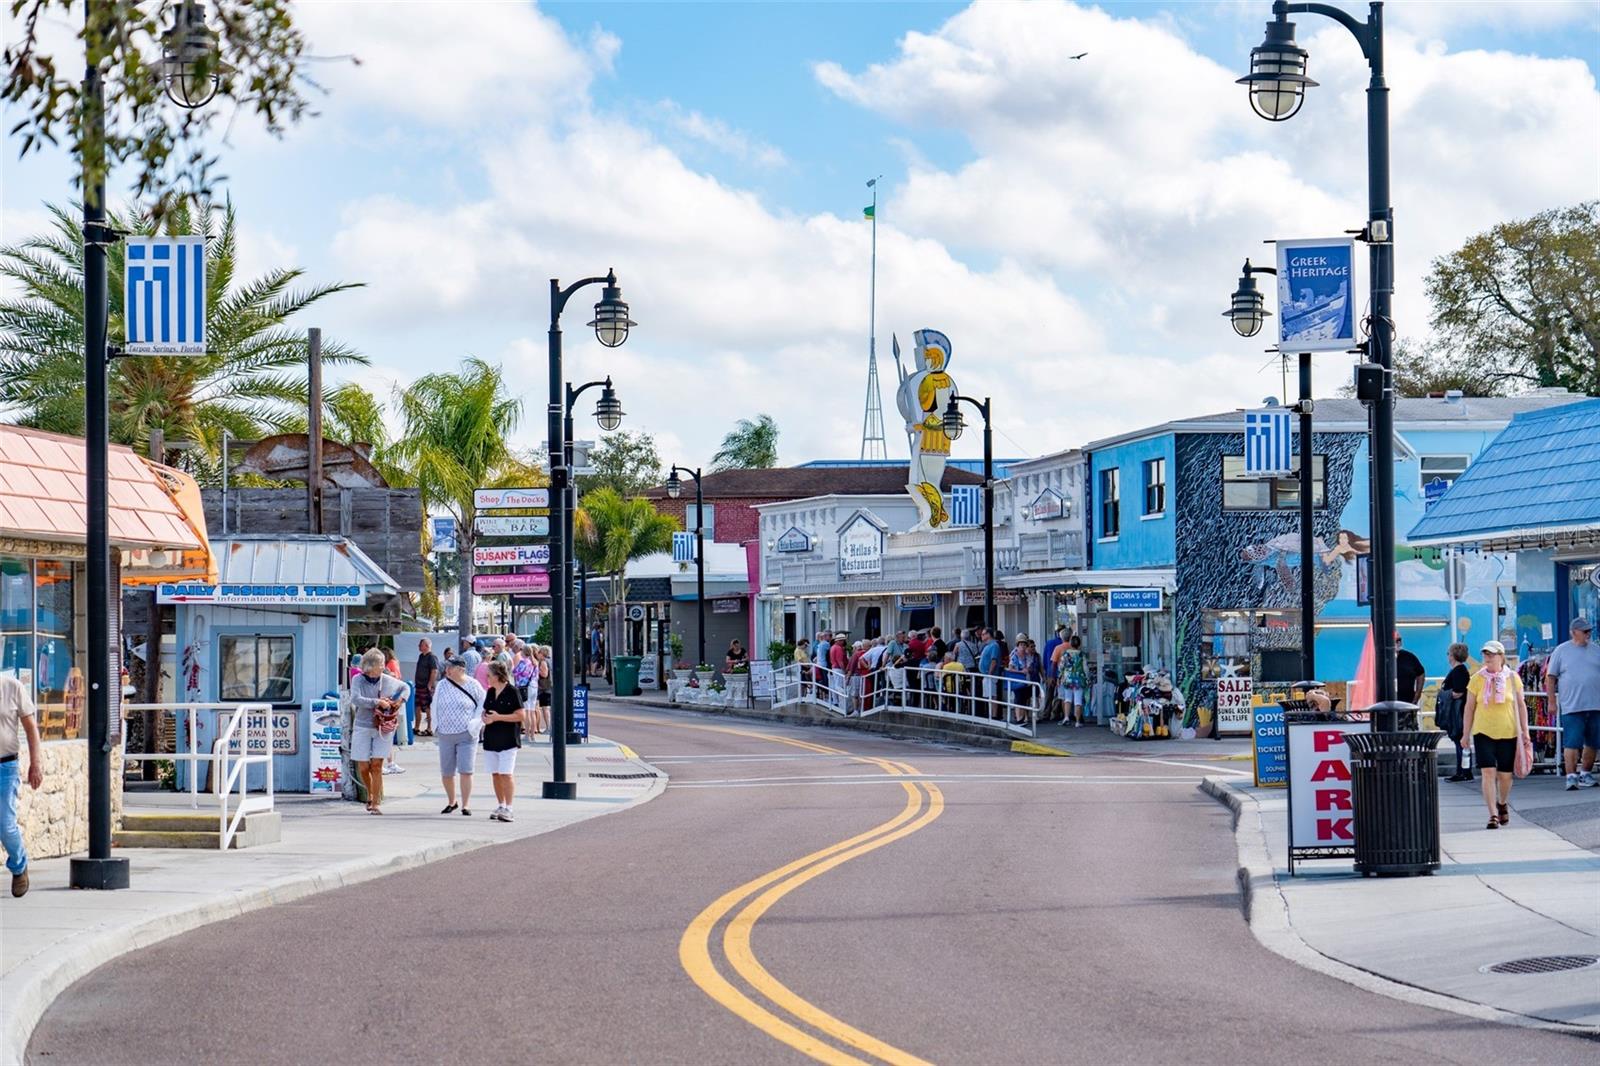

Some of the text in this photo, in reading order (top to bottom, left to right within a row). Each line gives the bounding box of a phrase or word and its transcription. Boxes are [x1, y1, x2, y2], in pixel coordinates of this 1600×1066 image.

[1291, 256, 1327, 267] GREEK
[1292, 266, 1348, 278] HERITAGE
[181, 344, 203, 352] Florida
[480, 495, 499, 505] Shop
[506, 496, 520, 504] The
[511, 524, 538, 532] BAR
[475, 550, 549, 560] SUSAN'S FLAGS
[850, 543, 871, 557] Hellas
[841, 557, 880, 571] Restaurant
[161, 585, 361, 596] DAILY FISHING TRIPS
[1112, 592, 1158, 600] GLORIA'S GIFTS
[1218, 680, 1251, 692] SALE
[1218, 694, 1241, 706] 5.99
[1311, 731, 1355, 840] PARK
